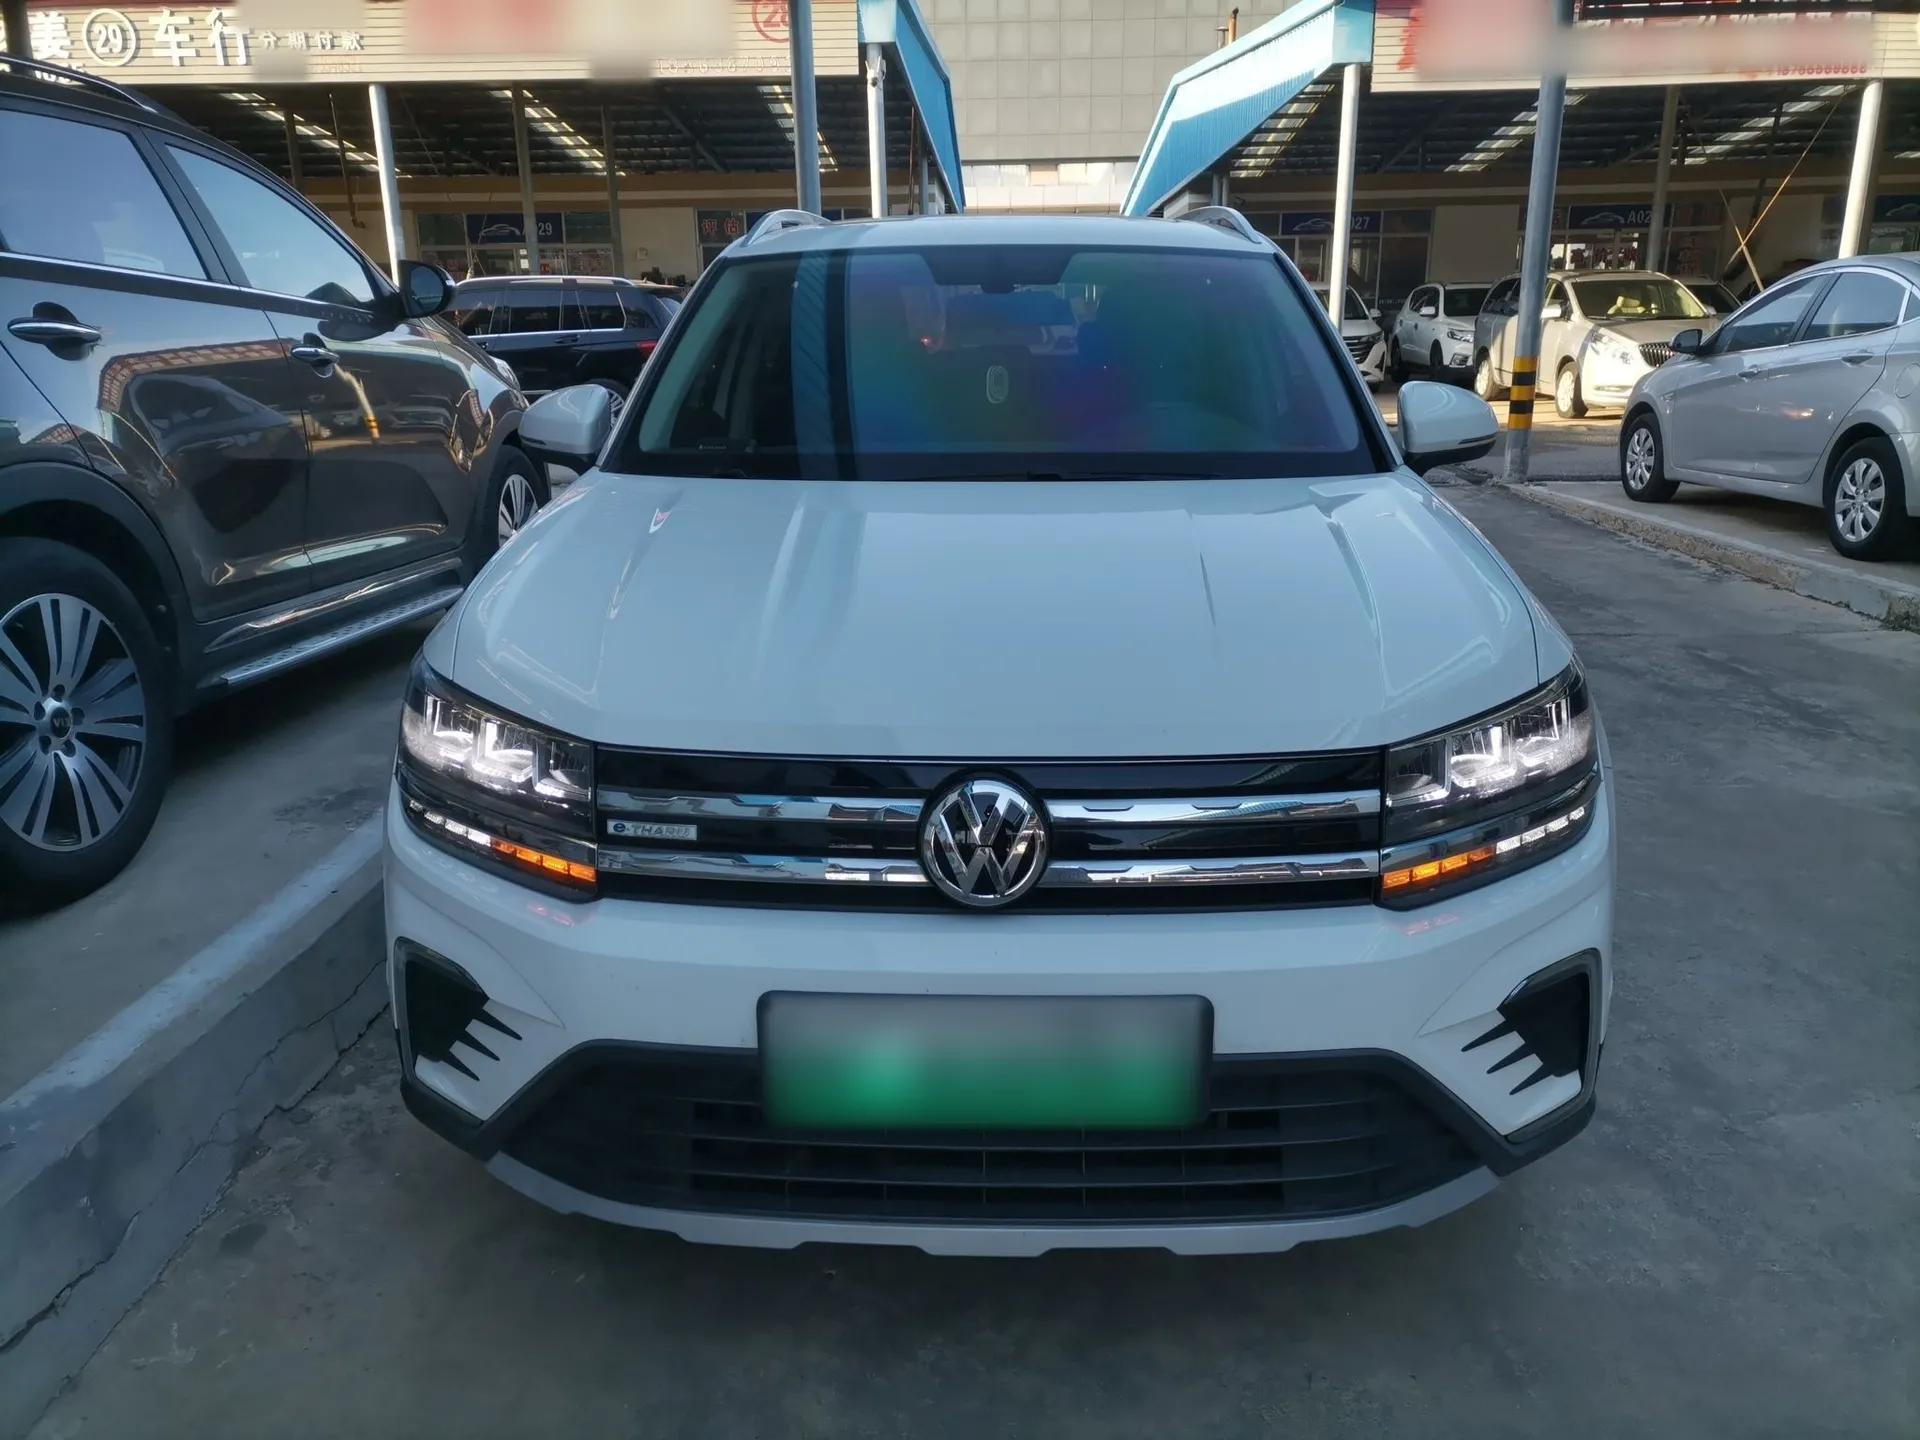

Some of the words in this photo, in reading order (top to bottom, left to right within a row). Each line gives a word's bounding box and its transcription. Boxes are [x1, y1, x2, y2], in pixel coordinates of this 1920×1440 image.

[148, 7, 250, 66] 车行
[260, 31, 363, 50] 分期付款
